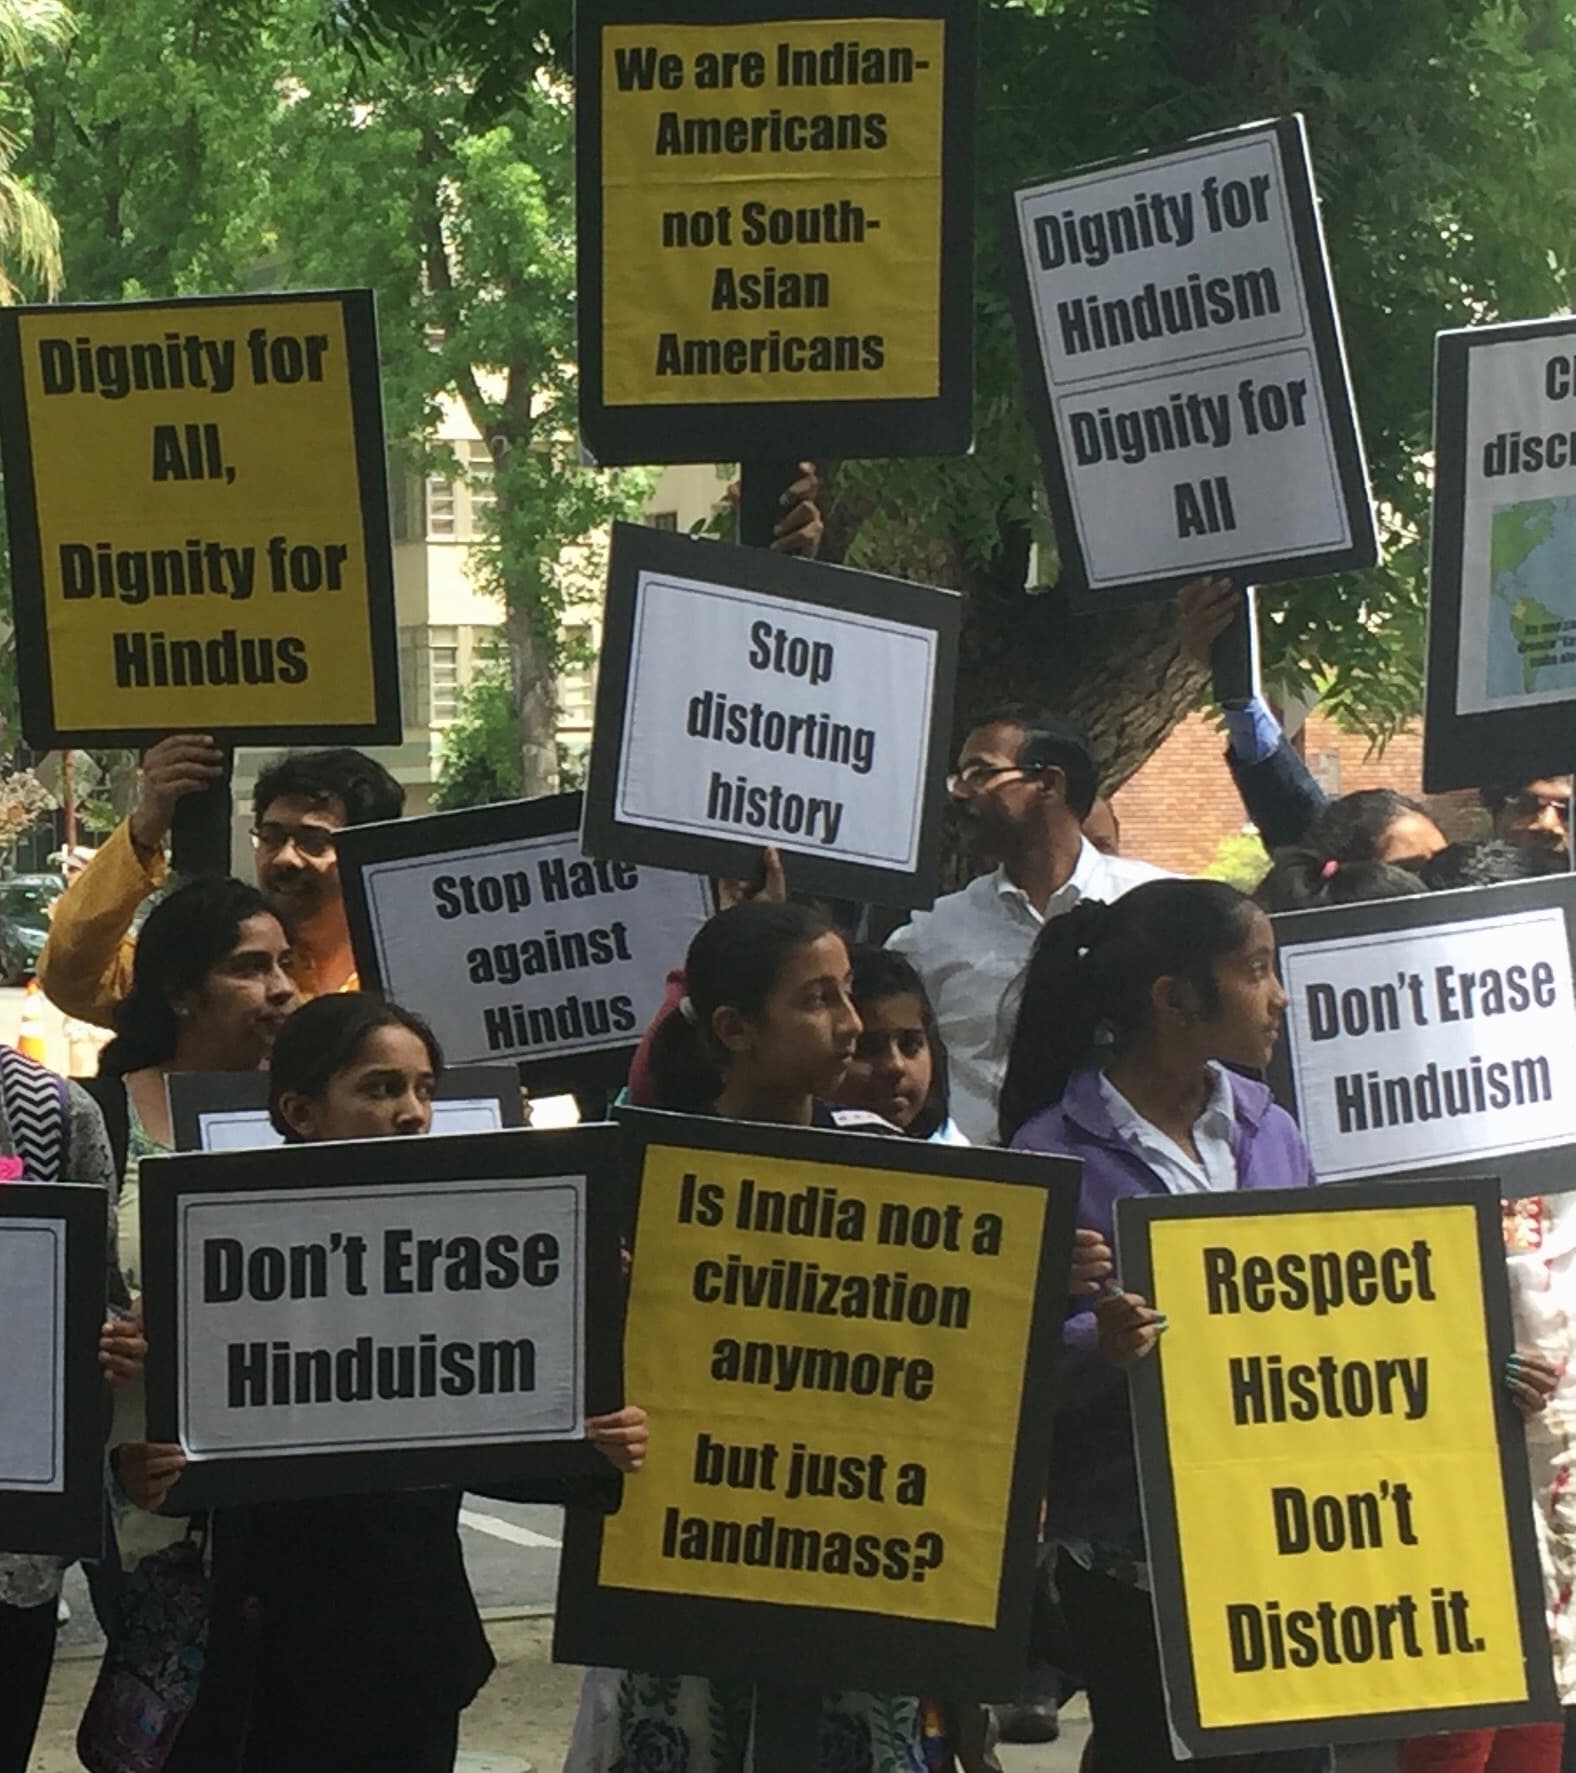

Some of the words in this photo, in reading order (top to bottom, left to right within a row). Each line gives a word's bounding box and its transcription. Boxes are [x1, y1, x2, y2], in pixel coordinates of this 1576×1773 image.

[614, 47, 684, 91] We
[695, 49, 765, 89] are
[777, 41, 930, 88] Indian-
[655, 109, 888, 155] Americans
[662, 206, 732, 247] not
[742, 200, 880, 246] South-
[1033, 192, 1194, 271] Dignity
[1201, 173, 1271, 235] for
[712, 267, 829, 311] Asian
[1057, 266, 1280, 356] Hinduism
[38, 332, 235, 400] Dignity
[247, 328, 329, 385] for
[656, 330, 885, 376] Americans
[1545, 355, 1576, 401] C
[152, 423, 235, 485] All,
[1068, 392, 1230, 467] Dignity
[1237, 377, 1307, 437] for
[1174, 475, 1236, 539] All
[60, 539, 255, 605] Dignity
[267, 536, 347, 593] for
[113, 630, 309, 688] Hindus
[749, 619, 834, 686] Stop
[686, 690, 876, 774] distorting
[707, 771, 843, 845] history
[432, 870, 530, 920] Stop
[538, 857, 639, 902] Hate
[467, 921, 632, 985] against
[483, 995, 636, 1051] Hindus
[1305, 971, 1429, 1042] Don't
[1434, 961, 1557, 1023] Erase
[1334, 1054, 1553, 1134] Hinduism
[677, 1173, 725, 1229] Is
[736, 1178, 867, 1243] India
[877, 1199, 963, 1252] not
[972, 1211, 1003, 1256] a
[203, 1231, 368, 1304] Don't
[383, 1229, 560, 1295] Erase
[692, 1254, 972, 1330] civilization
[1203, 1240, 1436, 1316] Respect
[227, 1334, 536, 1409] Hinduism
[710, 1337, 935, 1402] anymore
[1229, 1354, 1429, 1427] History
[693, 1432, 778, 1492] but
[785, 1443, 886, 1503] just
[896, 1461, 927, 1507] a
[662, 1507, 944, 1583] landmass?
[1271, 1479, 1419, 1556] Don't
[1226, 1594, 1423, 1674] Distort
[1430, 1587, 1486, 1656] it.
